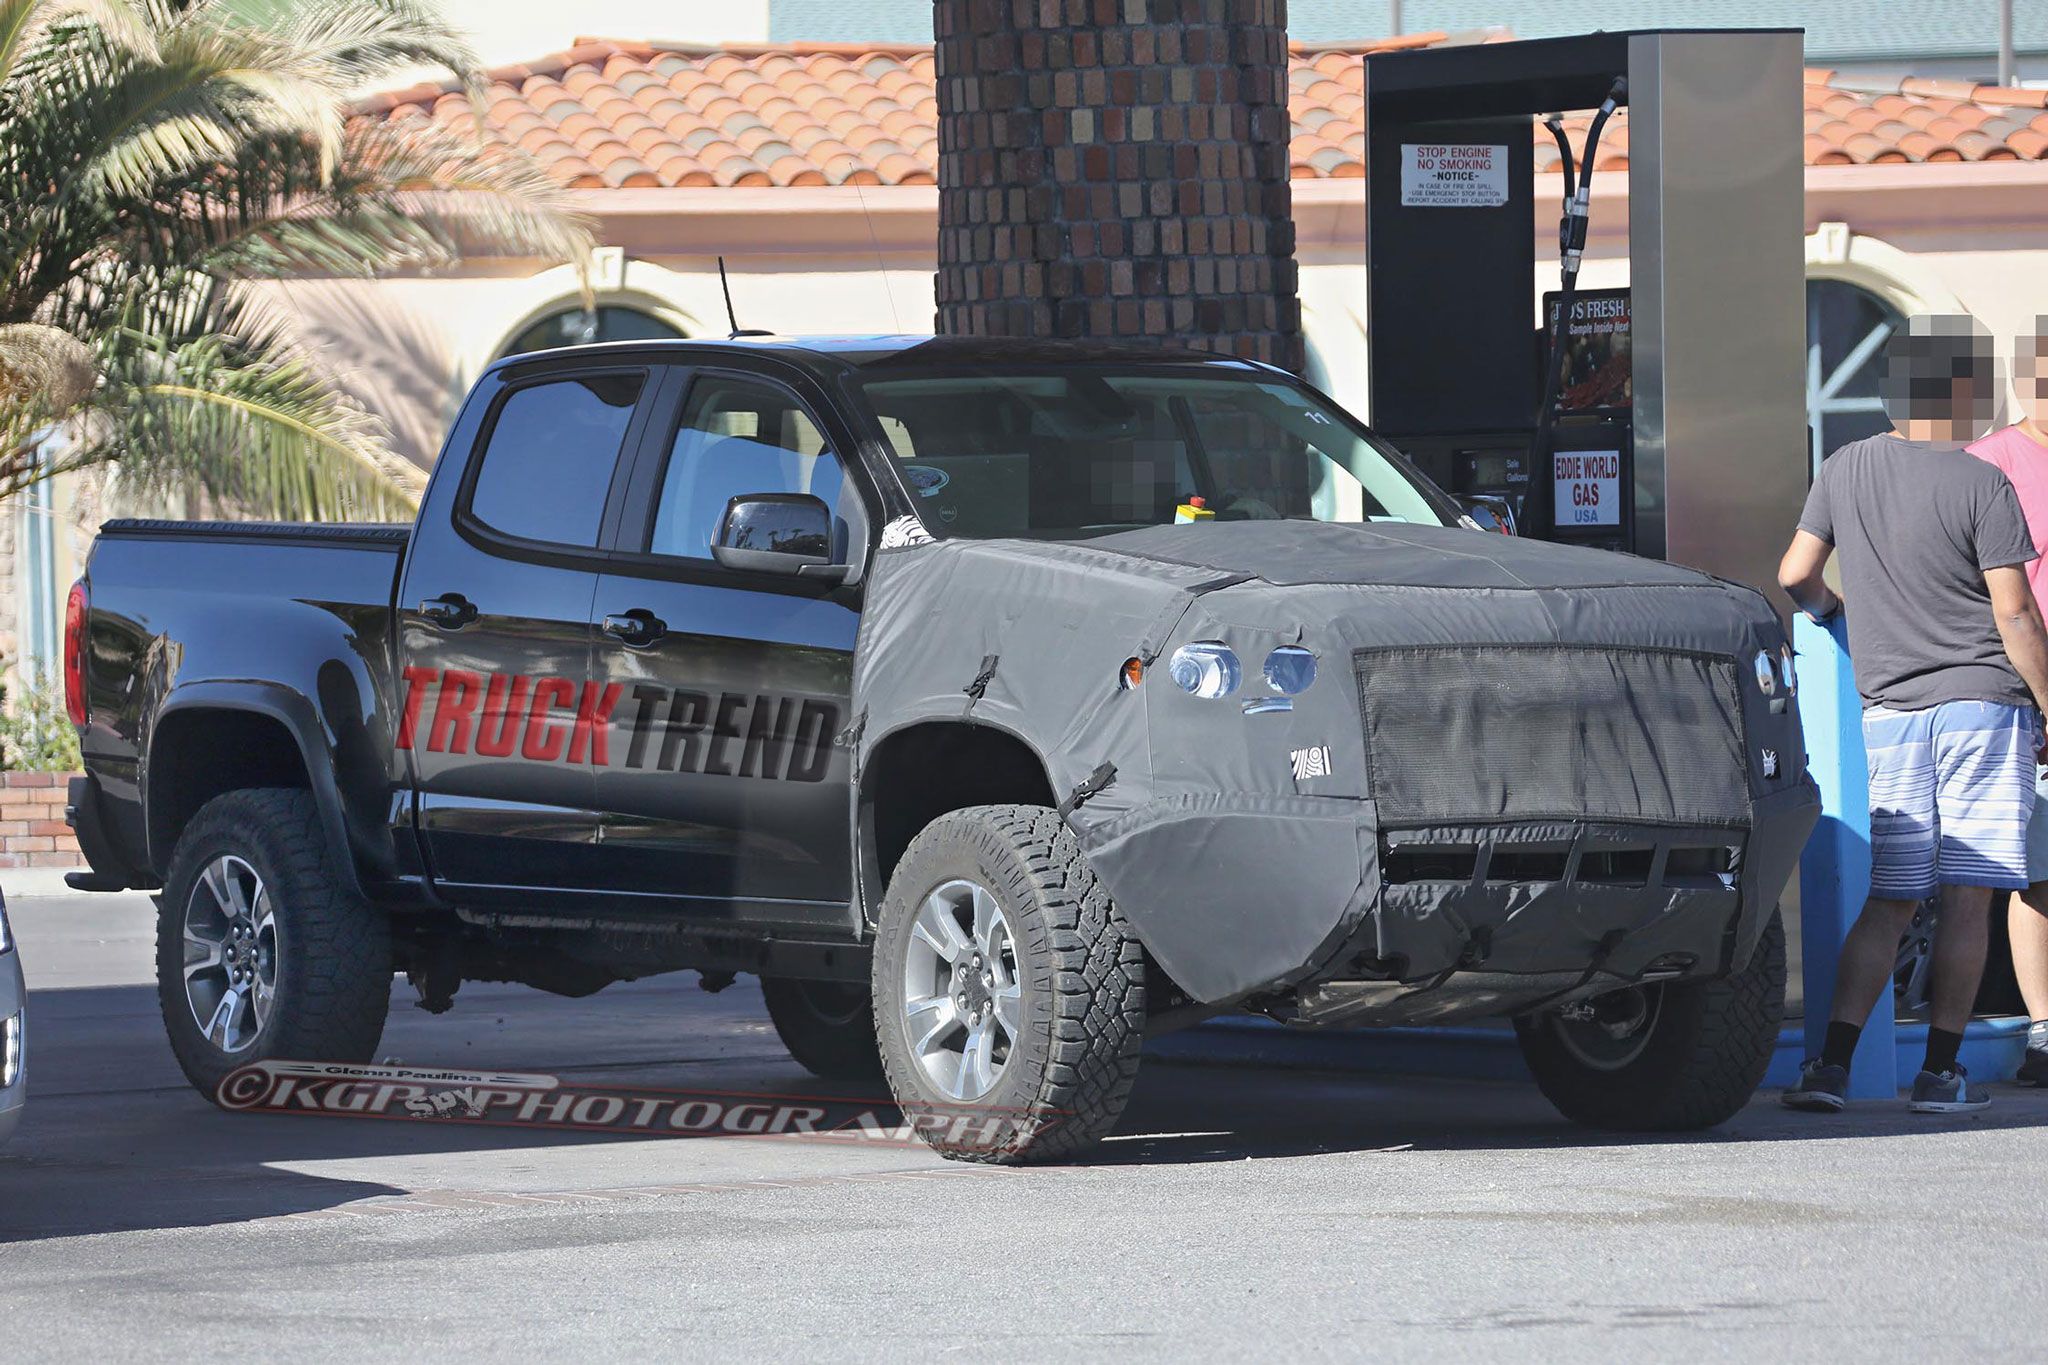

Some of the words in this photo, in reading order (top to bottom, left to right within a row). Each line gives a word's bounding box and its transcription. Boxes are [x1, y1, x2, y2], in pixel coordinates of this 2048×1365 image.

[1417, 147, 1447, 158] STOP
[1451, 147, 1492, 158] ENGINE
[1417, 159, 1434, 170] NO
[1439, 159, 1492, 170] SMOKING
[1587, 299, 1625, 319] FRESH
[1569, 323, 1593, 336] Sample
[1555, 457, 1582, 480] EDDIE
[1583, 456, 1618, 479] WORLD
[1573, 483, 1599, 506] GAS
[1574, 509, 1599, 523] USA
